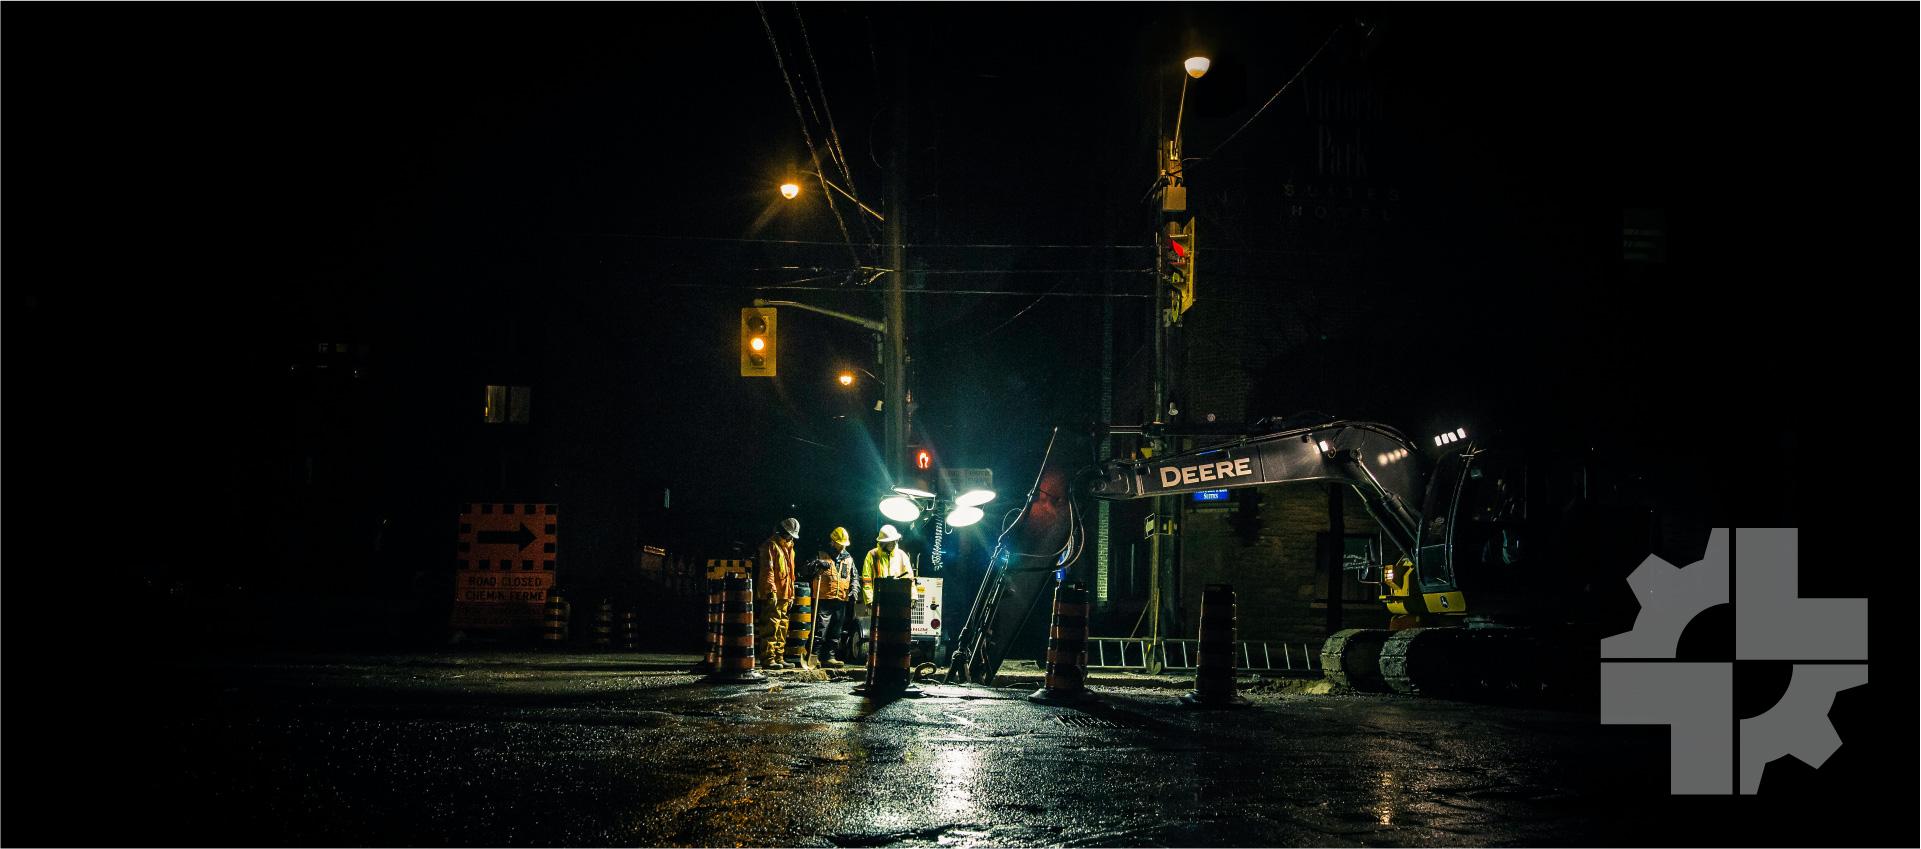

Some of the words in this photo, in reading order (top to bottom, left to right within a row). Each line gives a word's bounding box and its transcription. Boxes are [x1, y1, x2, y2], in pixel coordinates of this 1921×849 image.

[1318, 124, 1368, 177] Park
[1159, 457, 1253, 488] DEERE
[468, 576, 497, 587] ROAD
[502, 576, 542, 587] CLOSED
[465, 591, 506, 601] CHEMIN
